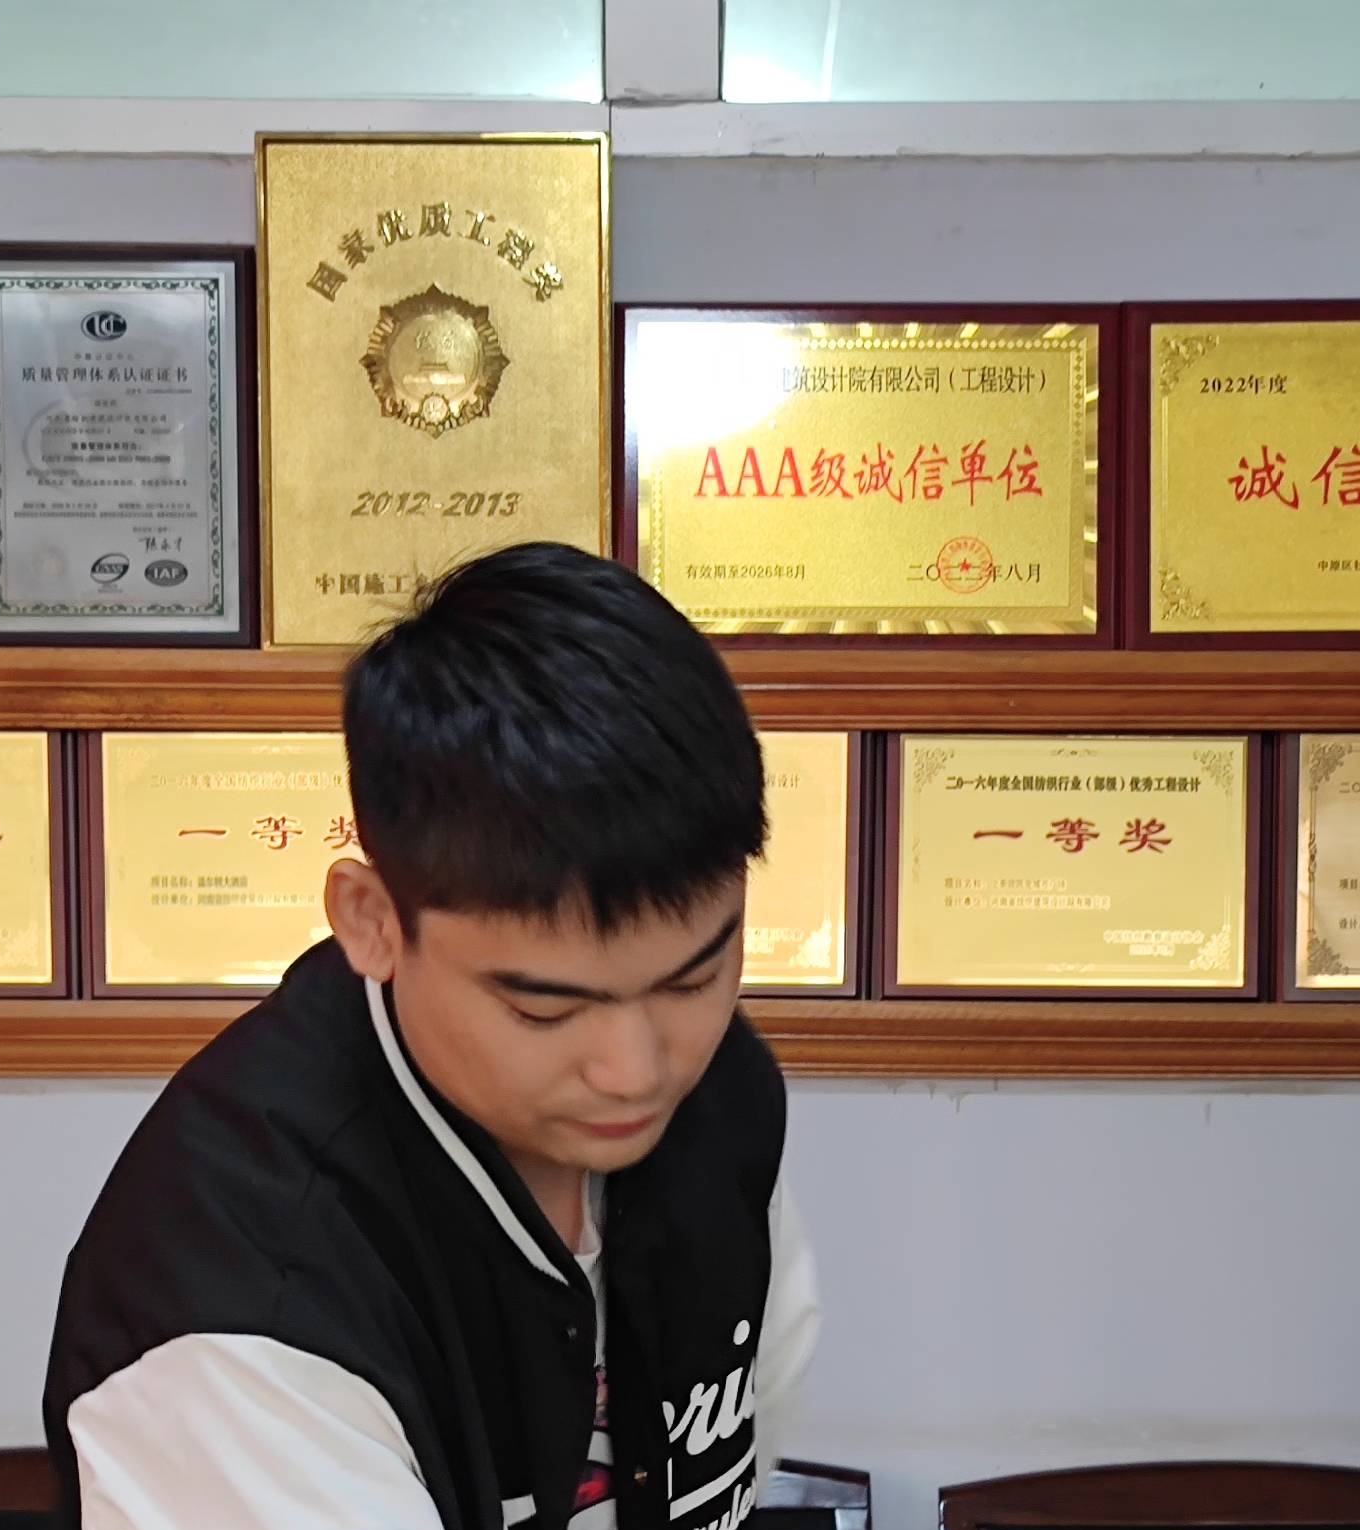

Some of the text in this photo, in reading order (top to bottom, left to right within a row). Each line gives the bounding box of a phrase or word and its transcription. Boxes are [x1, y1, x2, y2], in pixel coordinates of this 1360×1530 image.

[22, 366, 188, 382] 质量管理体系认证证书
[1200, 374, 1288, 396] 2022年度
[694, 439, 1044, 507] AAA级诚信单位
[351, 491, 522, 517] 2012-2013
[154, 568, 180, 579] IAF
[973, 817, 1173, 854] 一等奖
